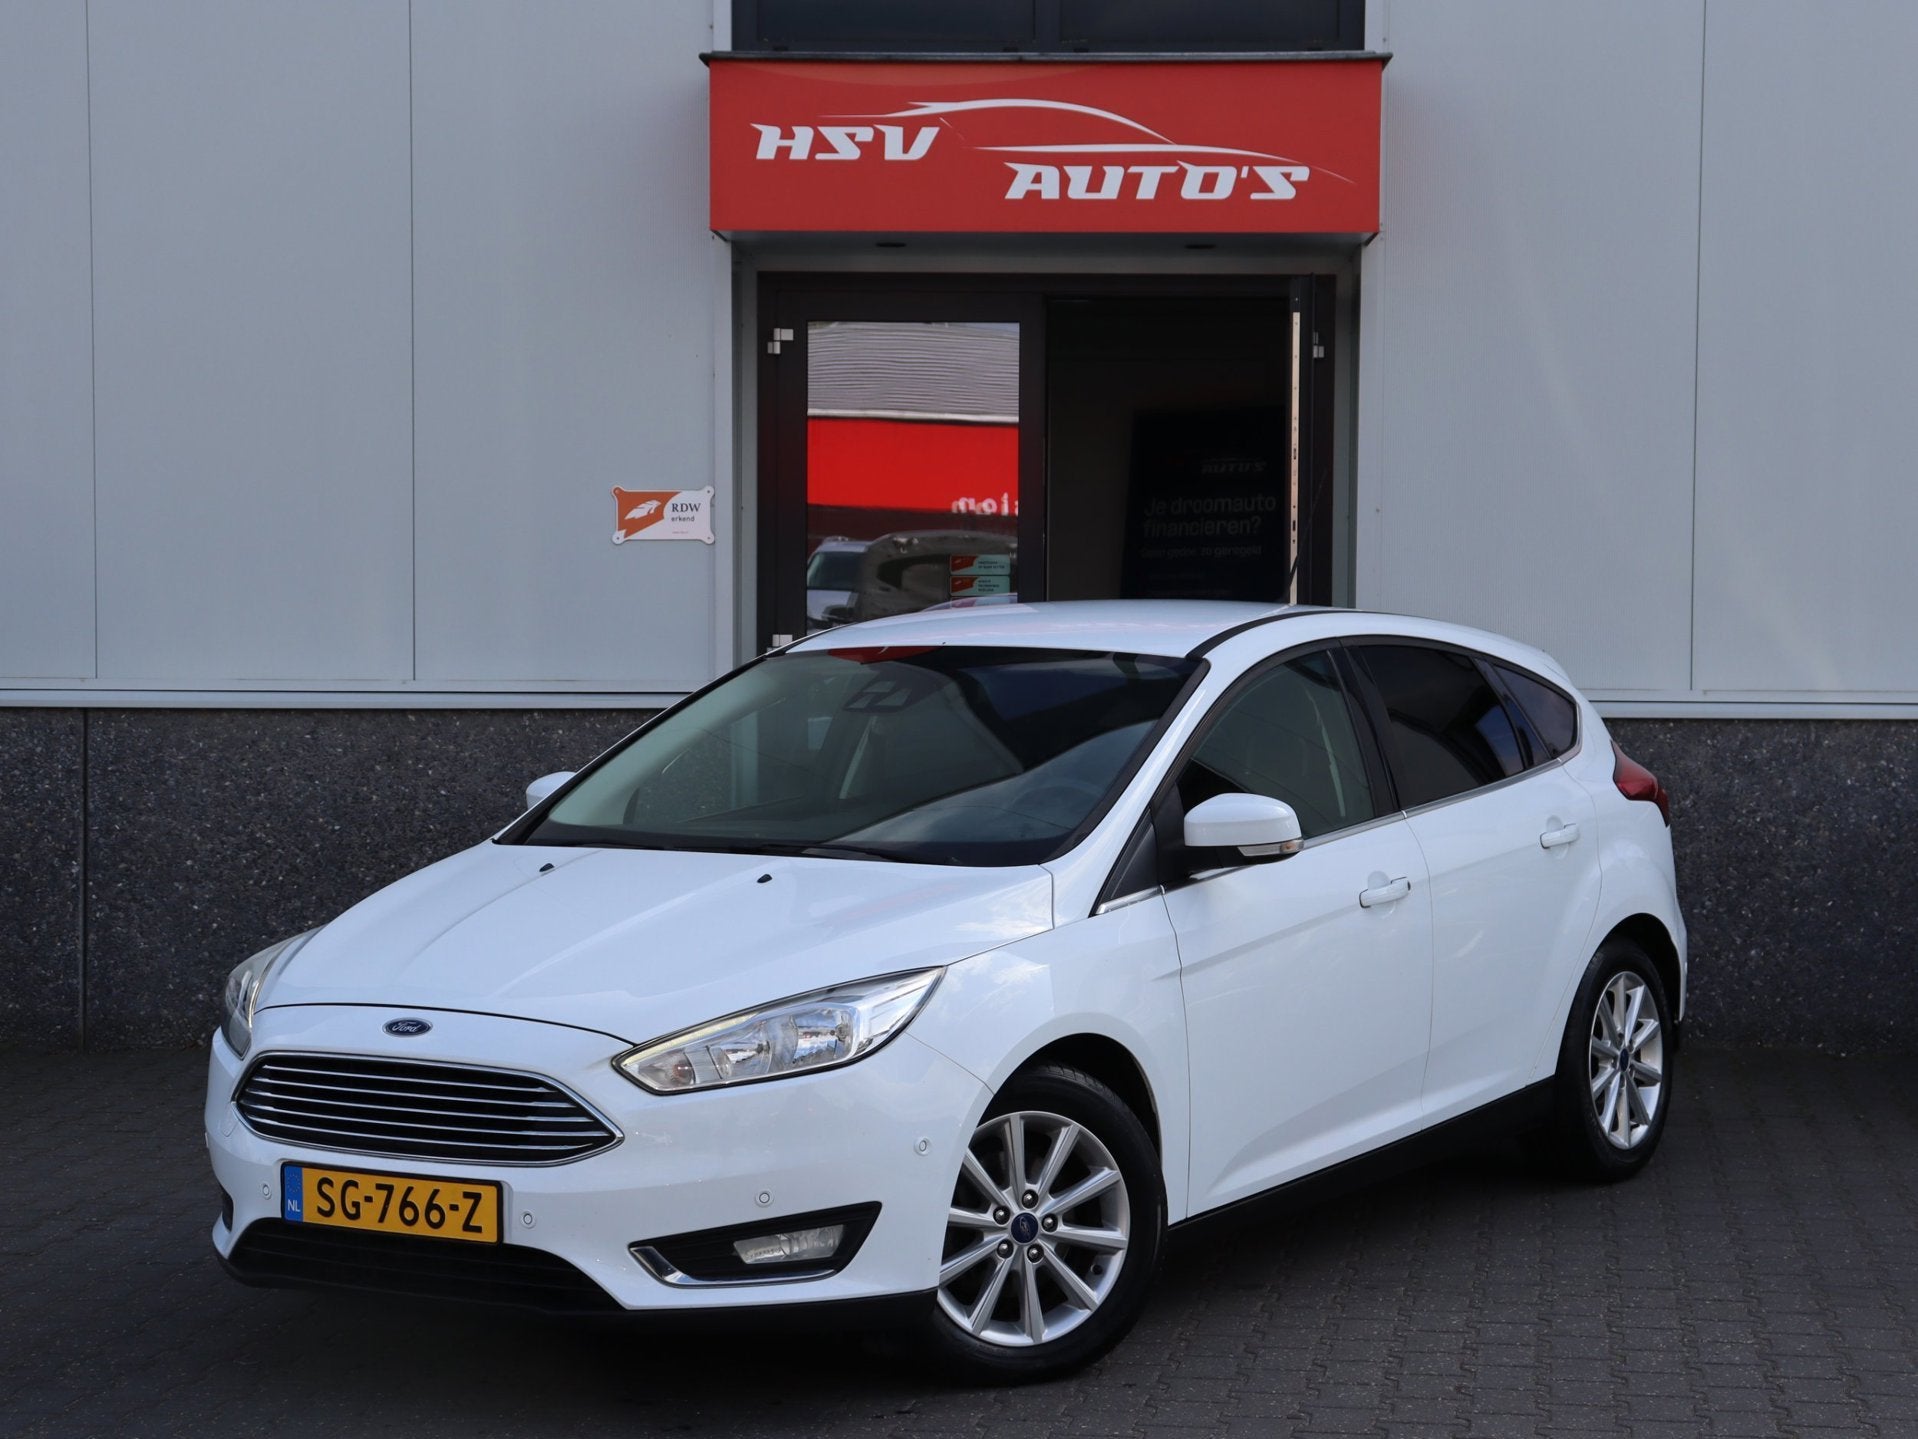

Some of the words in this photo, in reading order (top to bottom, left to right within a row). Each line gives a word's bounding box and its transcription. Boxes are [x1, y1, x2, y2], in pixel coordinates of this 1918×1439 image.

[750, 123, 940, 161] HSV
[1003, 160, 1311, 200] AUTO'S
[672, 503, 701, 512] RDW
[1144, 497, 1167, 515] Je
[1170, 493, 1277, 514] droomauto
[1143, 515, 1262, 538] financieren?
[392, 1021, 421, 1033] Ford
[287, 1199, 301, 1213] NL
[316, 1177, 483, 1233] SG-766-Z
